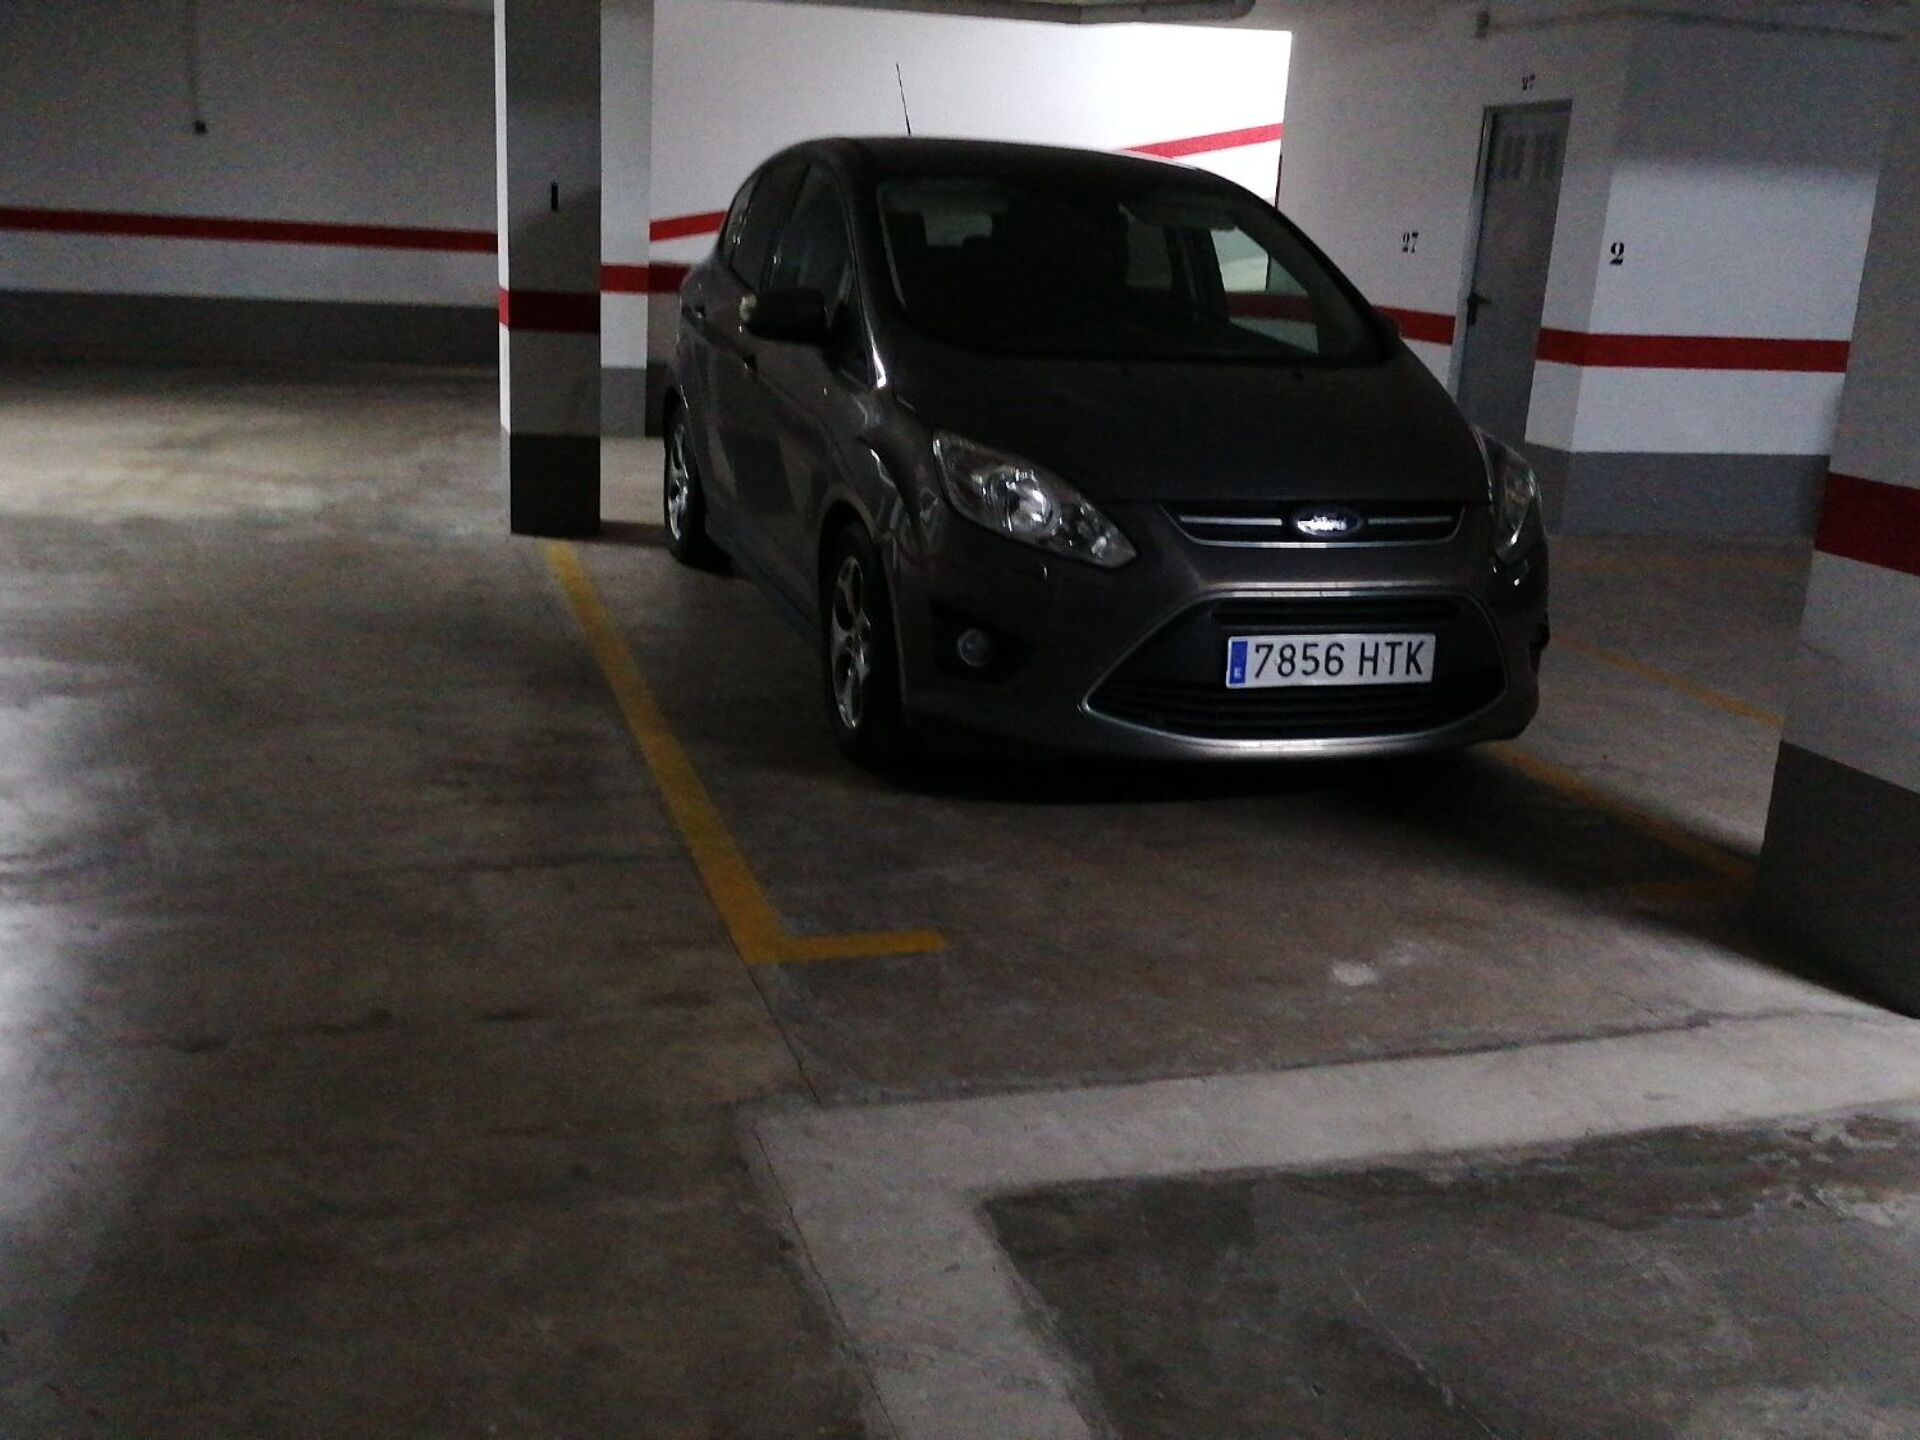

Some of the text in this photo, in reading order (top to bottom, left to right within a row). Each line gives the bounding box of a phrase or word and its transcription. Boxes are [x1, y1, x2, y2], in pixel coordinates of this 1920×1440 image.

[1402, 231, 1419, 254] 27
[1610, 242, 1625, 266] 2
[1254, 641, 1424, 679] 7856 HTK
